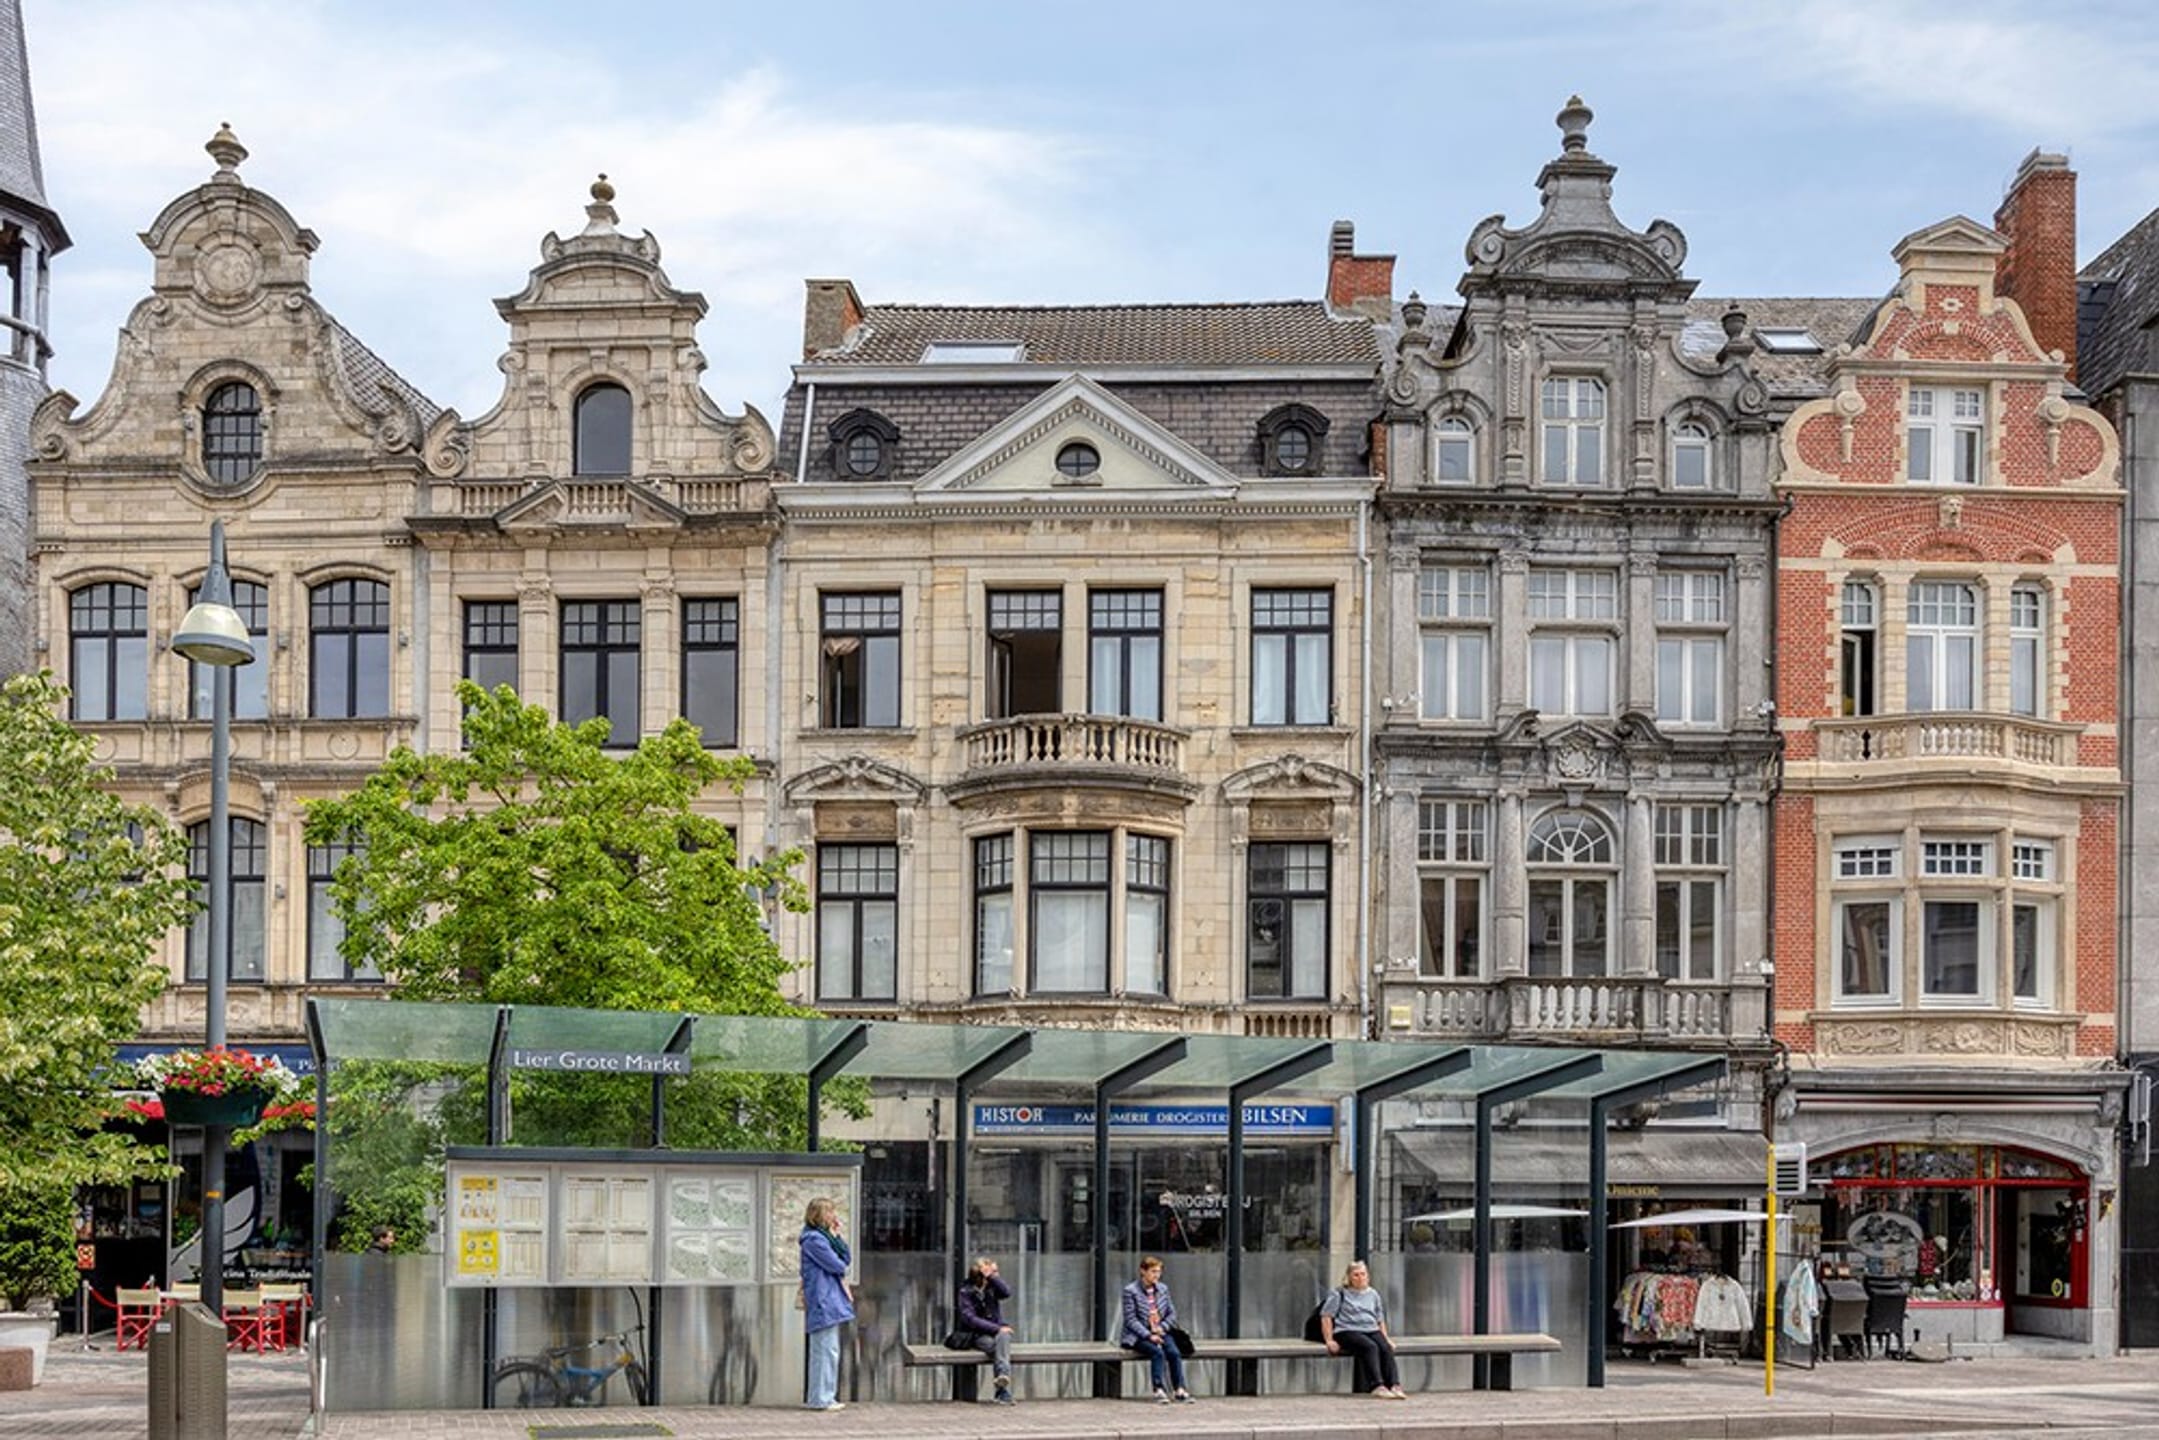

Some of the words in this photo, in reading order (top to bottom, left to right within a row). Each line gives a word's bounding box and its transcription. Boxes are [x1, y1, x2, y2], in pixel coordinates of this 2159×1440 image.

[513, 1050, 552, 1068] Lier
[558, 1051, 619, 1070] Grote
[625, 1054, 681, 1073] Markt
[982, 1107, 1044, 1123] HISTOR
[1242, 1107, 1308, 1124] BILSEN
